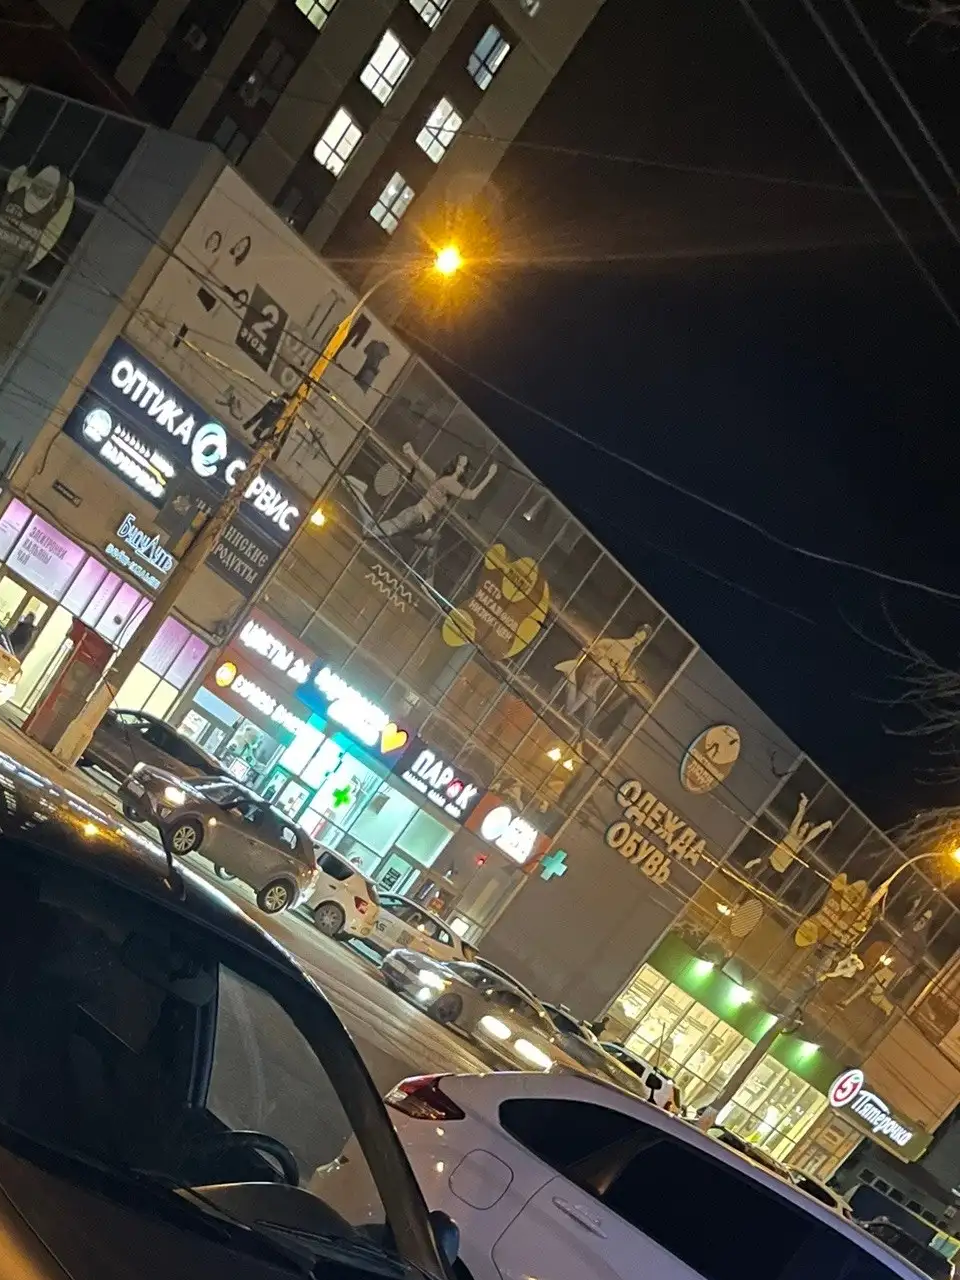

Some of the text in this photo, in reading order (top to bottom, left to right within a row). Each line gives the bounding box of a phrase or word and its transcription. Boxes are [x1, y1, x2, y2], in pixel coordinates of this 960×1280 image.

[252, 304, 279, 341] 2
[111, 358, 195, 445] ОПТИКА
[225, 459, 299, 531] СРВИС
[483, 580, 501, 600] СЕТЬ
[606, 821, 672, 884] ОБУВЬ
[616, 779, 706, 866] ОДЕЖДА
